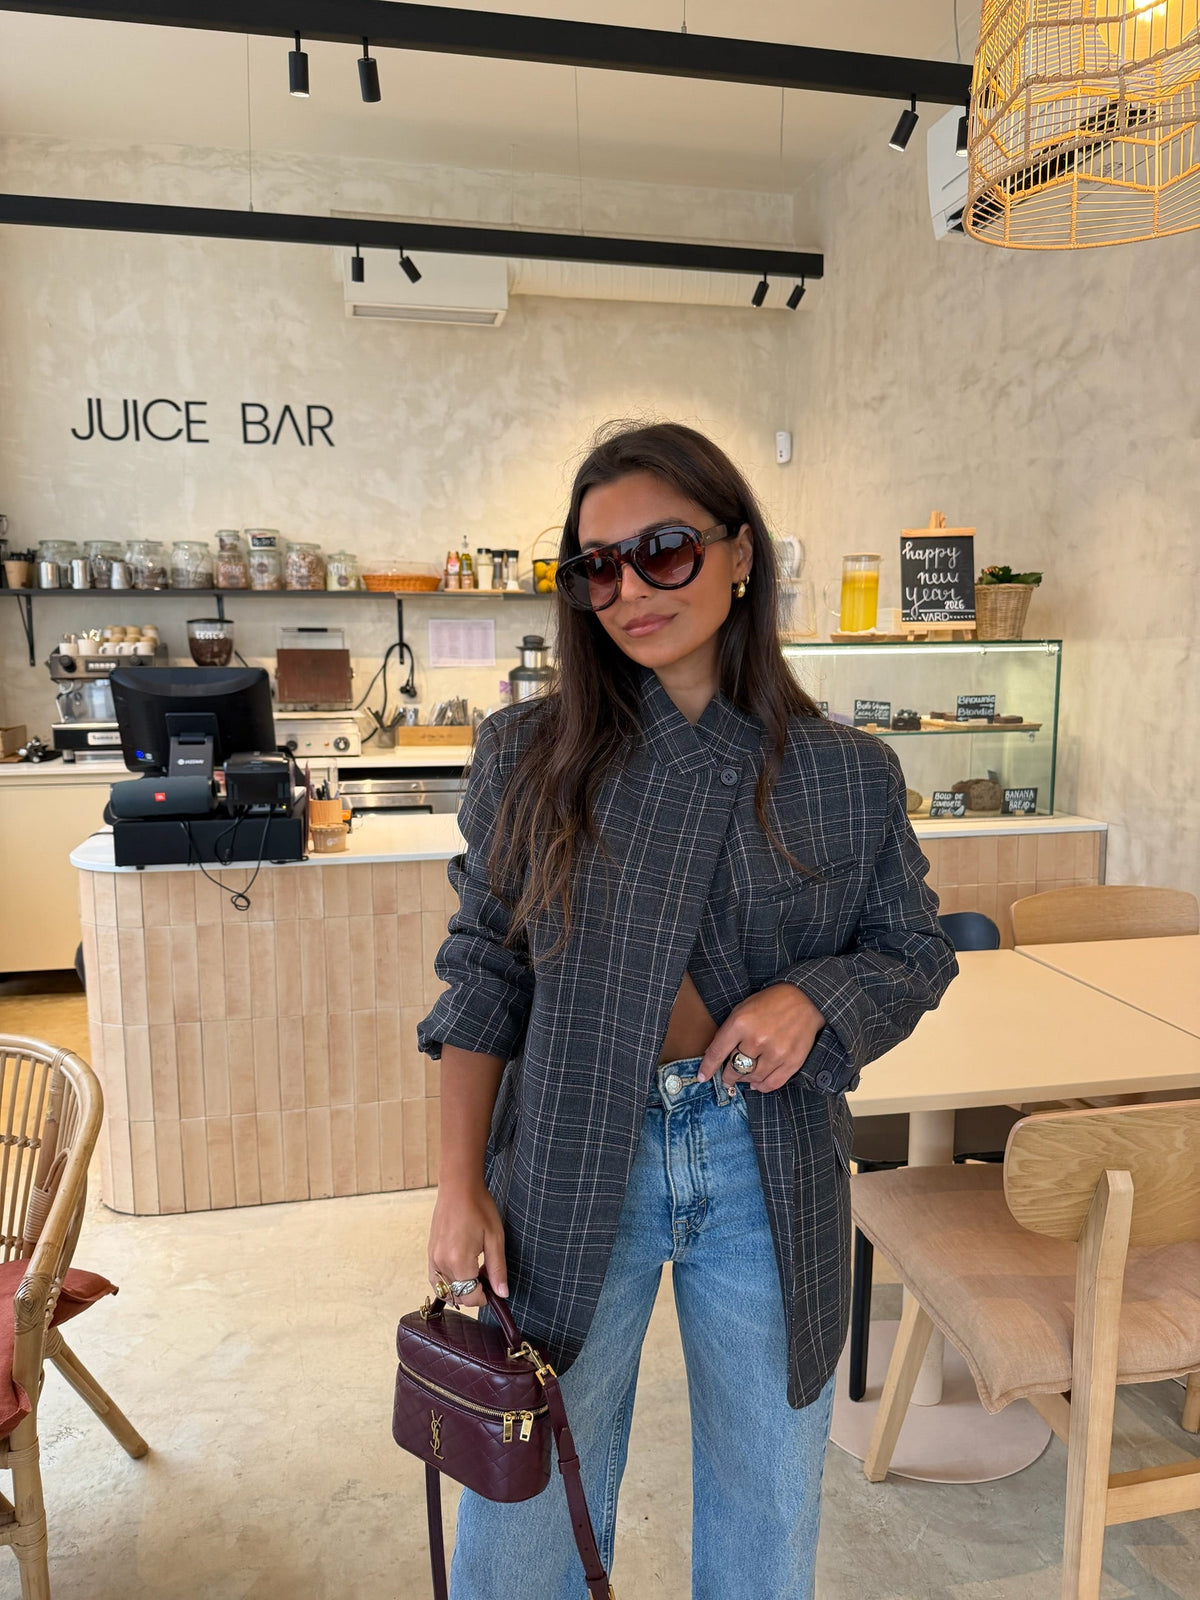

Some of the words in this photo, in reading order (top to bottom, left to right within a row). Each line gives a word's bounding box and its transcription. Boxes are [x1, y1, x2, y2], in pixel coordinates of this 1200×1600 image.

[71, 397, 210, 443] JUICE
[240, 402, 335, 447] BAR
[902, 541, 960, 570] happy
[917, 571, 960, 585] new
[944, 599, 965, 610] 2026
[1004, 789, 1035, 802] BANANA
[429, 1409, 445, 1460] YSL
